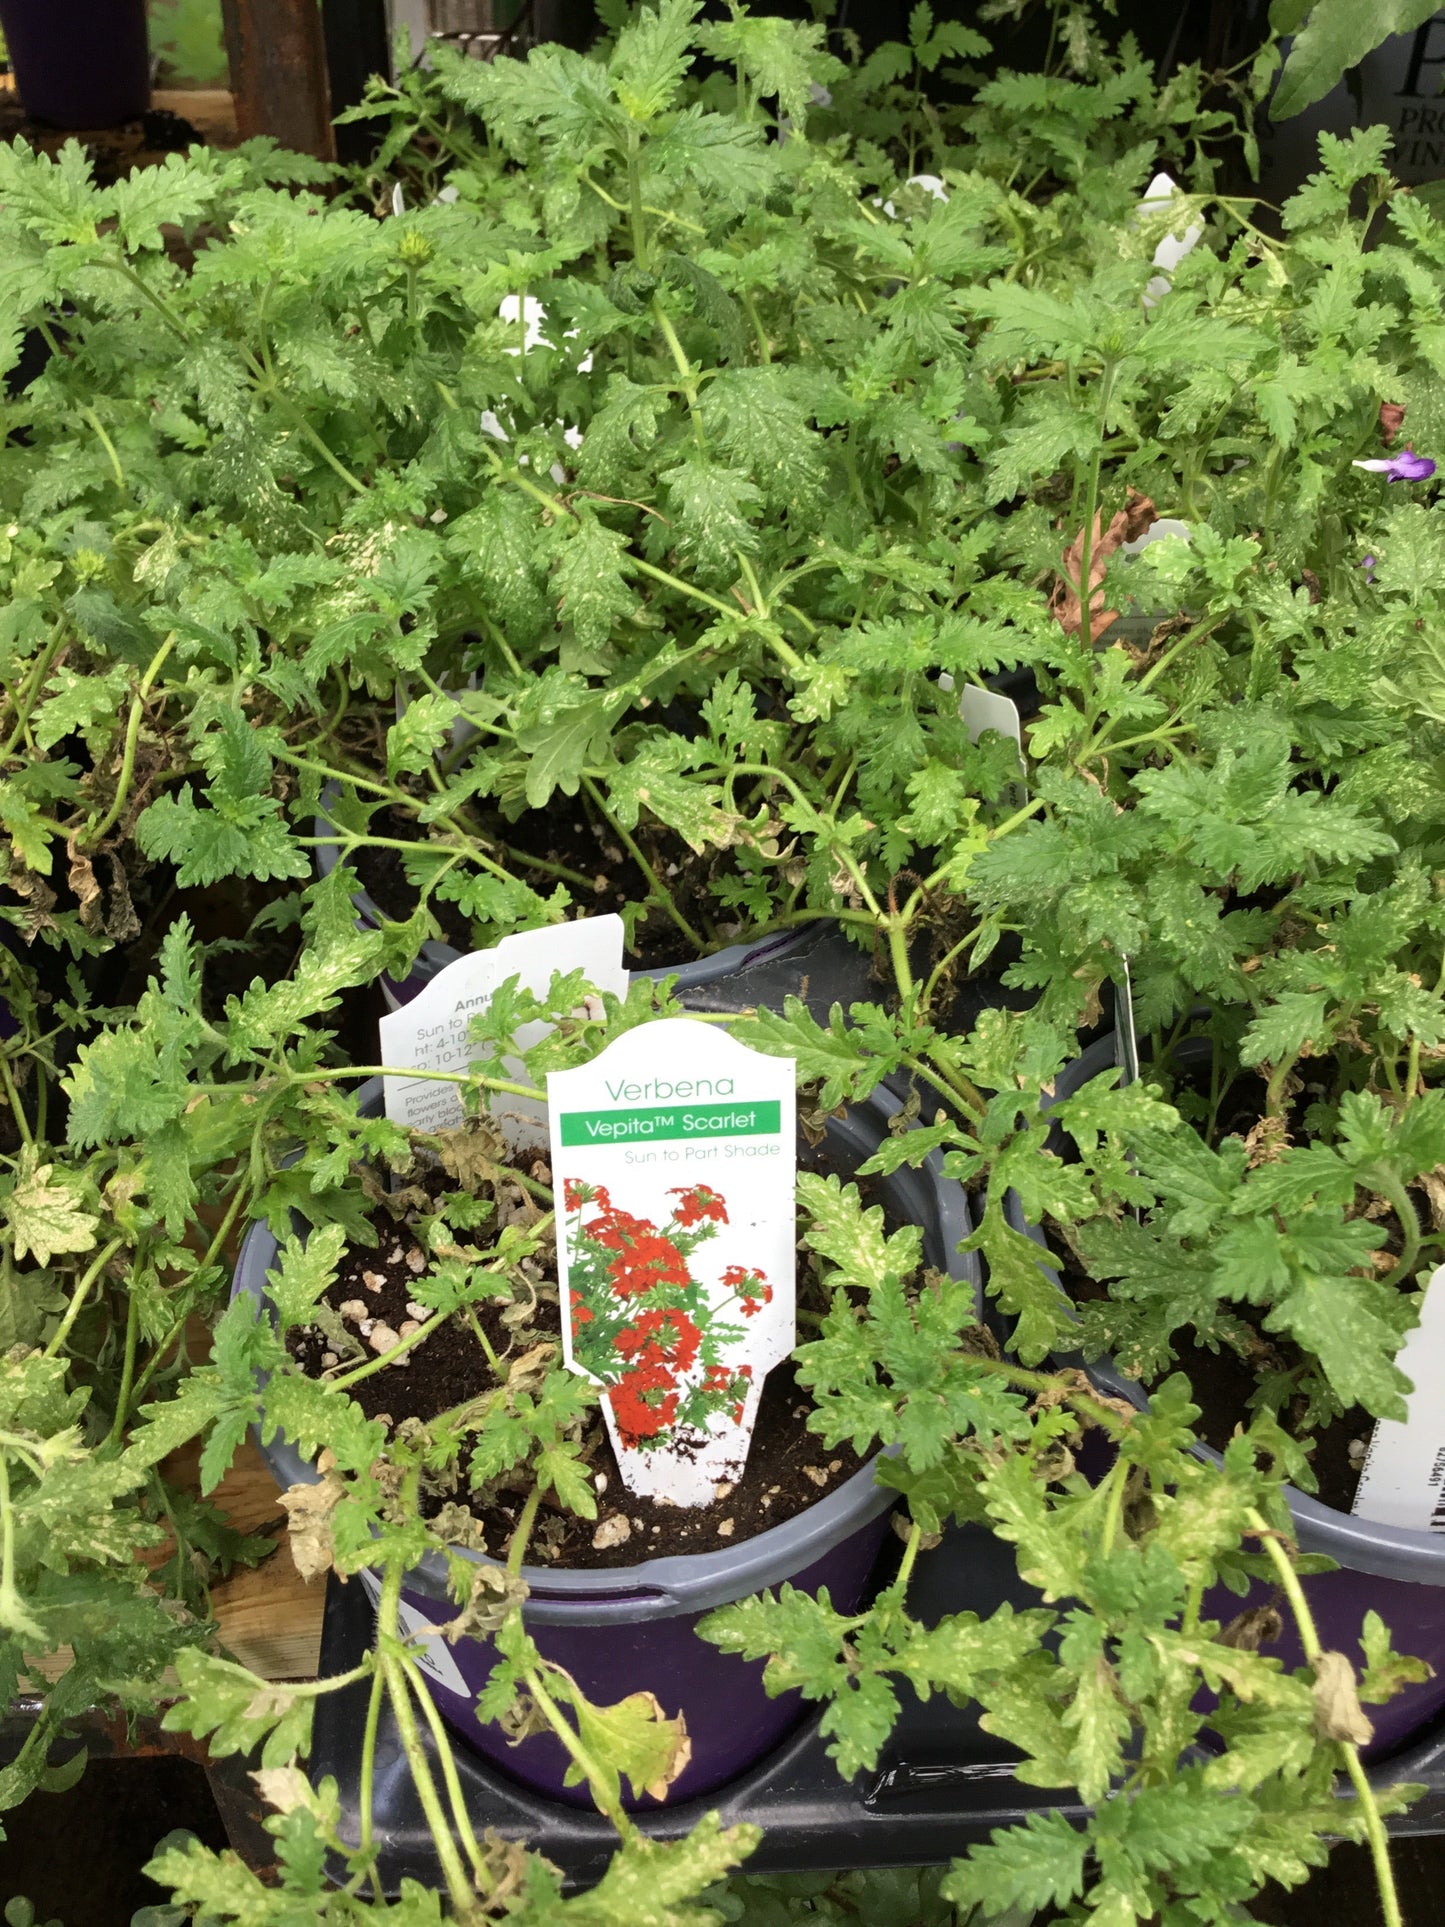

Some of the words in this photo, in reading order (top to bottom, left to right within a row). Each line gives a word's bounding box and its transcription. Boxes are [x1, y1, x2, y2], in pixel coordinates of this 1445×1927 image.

[455, 993, 492, 1012] Annu
[416, 1024, 444, 1040] Sun
[449, 1018, 462, 1030] to
[414, 1043, 433, 1056] ht:
[405, 1085, 454, 1106] Provides
[605, 1077, 734, 1101] Verbena
[407, 1098, 447, 1117] flowers
[682, 1111, 756, 1131] Scarlet
[624, 1150, 657, 1164] Sun
[663, 1149, 680, 1162] to
[685, 1145, 718, 1160] Part
[724, 1142, 781, 1157] Shade
